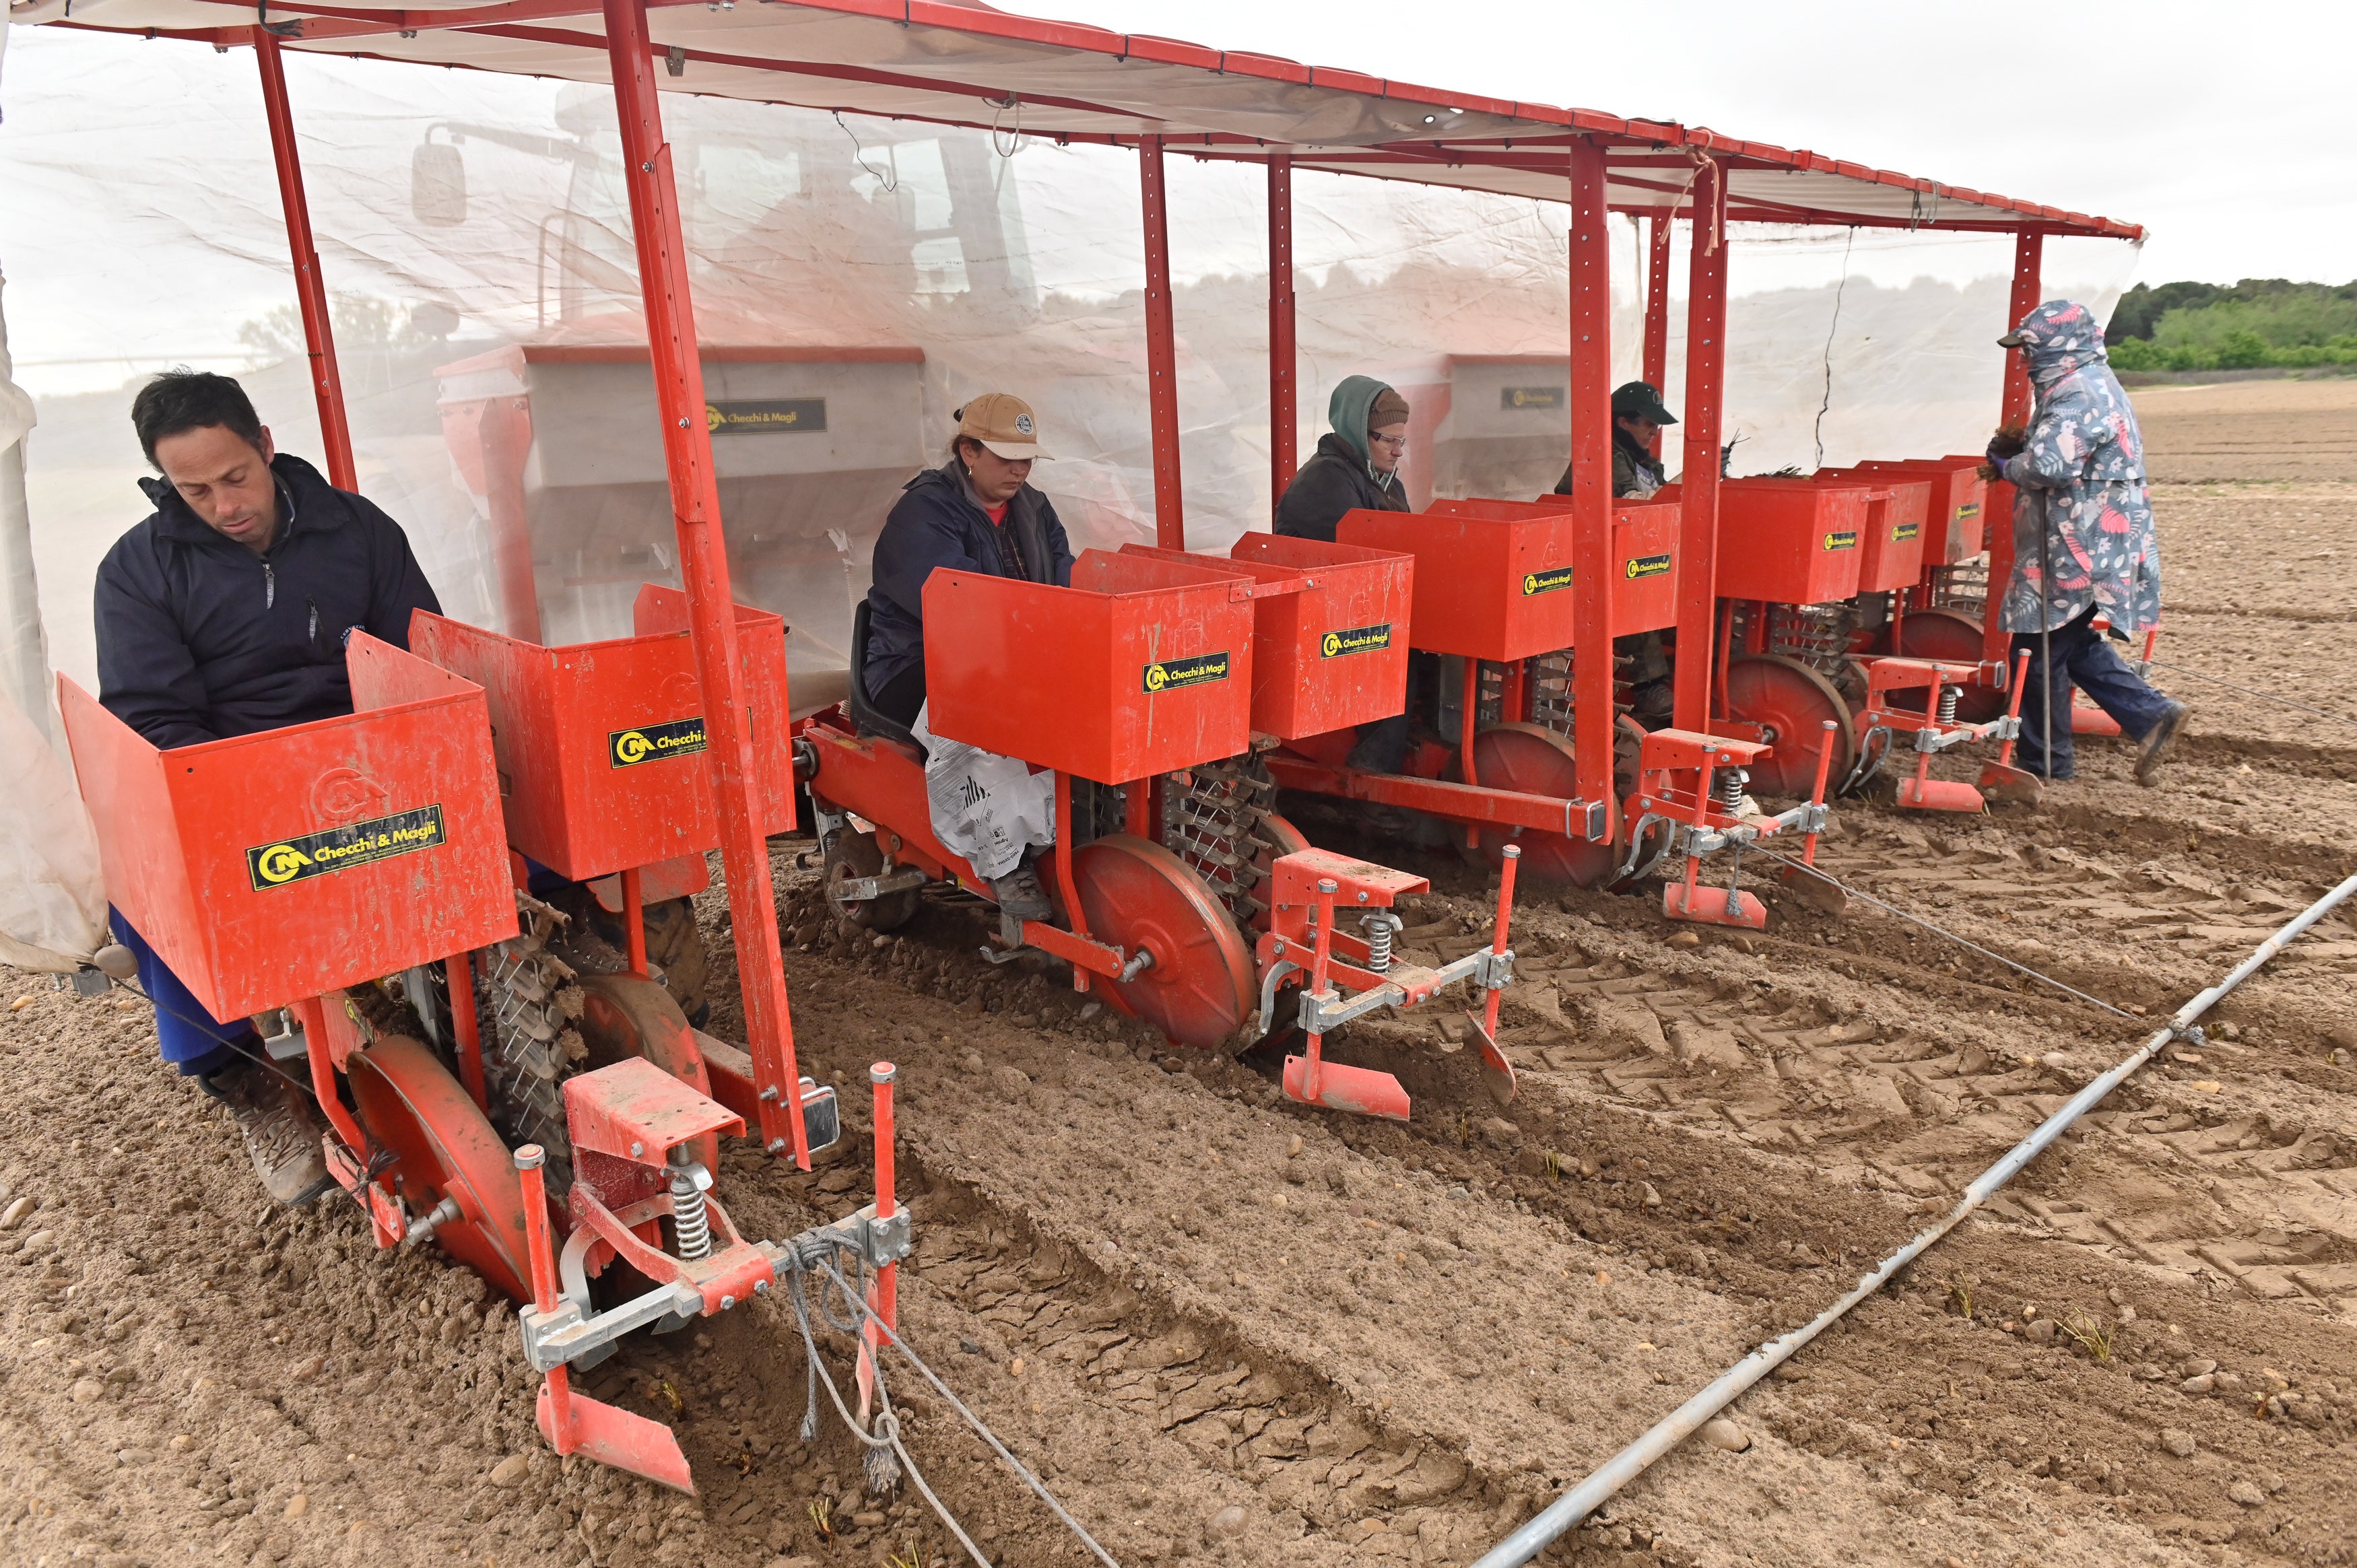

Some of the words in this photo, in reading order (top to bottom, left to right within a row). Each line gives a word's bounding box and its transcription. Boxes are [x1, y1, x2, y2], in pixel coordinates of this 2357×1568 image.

[728, 413, 762, 423] Checchi
[762, 413, 770, 421] &
[772, 412, 797, 423] Magli
[1343, 636, 1366, 648] Checchi
[1366, 636, 1371, 644] &
[1371, 632, 1388, 644] Magli
[1170, 667, 1199, 680] Checchi
[1199, 666, 1205, 675] &
[1205, 662, 1226, 675] Magli
[657, 730, 702, 749] Checchi
[314, 836, 375, 862] Checchi
[378, 833, 391, 847] &
[393, 821, 436, 844] Magli
